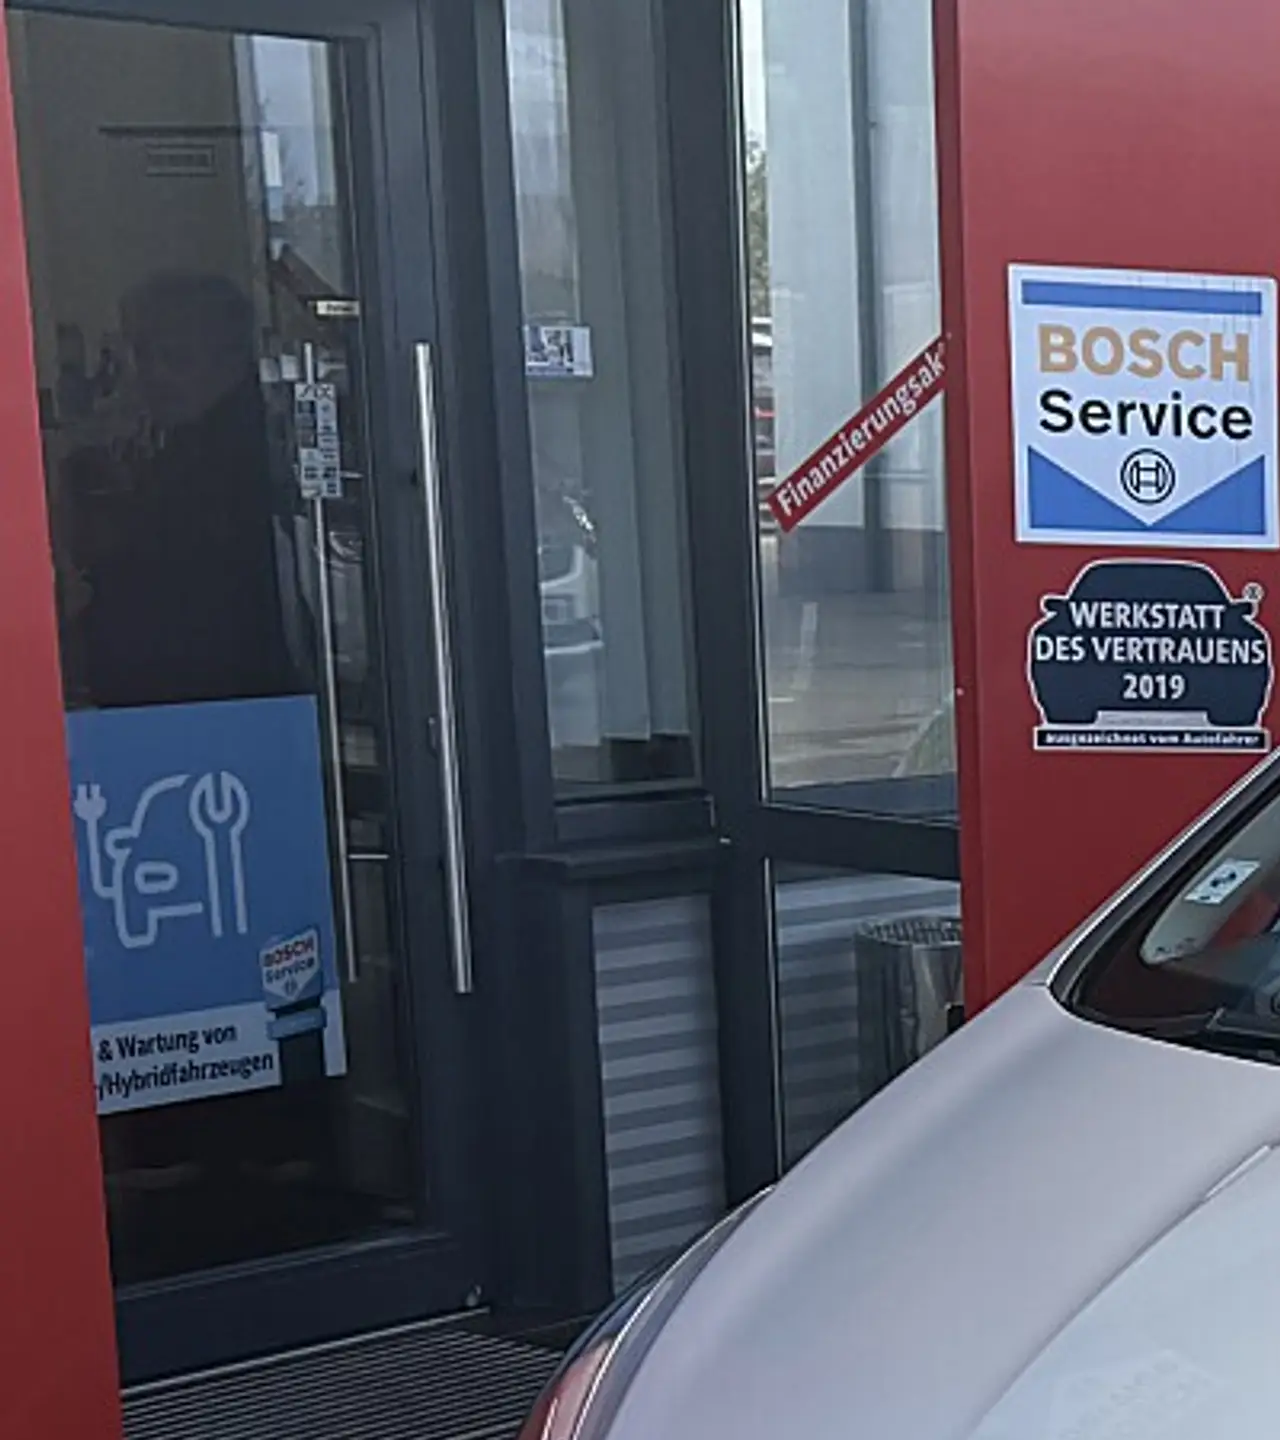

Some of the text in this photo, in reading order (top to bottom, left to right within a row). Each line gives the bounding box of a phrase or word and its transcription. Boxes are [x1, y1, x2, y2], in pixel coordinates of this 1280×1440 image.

[1038, 324, 1250, 383] BOSCH
[1038, 388, 1253, 441] Service
[1069, 601, 1225, 630] WERKSTATT
[1035, 636, 1266, 665] DES VERTRAUENS
[1122, 673, 1186, 700] 2019
[264, 937, 315, 967] BOSCH
[265, 956, 315, 983] Service
[97, 1024, 238, 1063] & Wartung von
